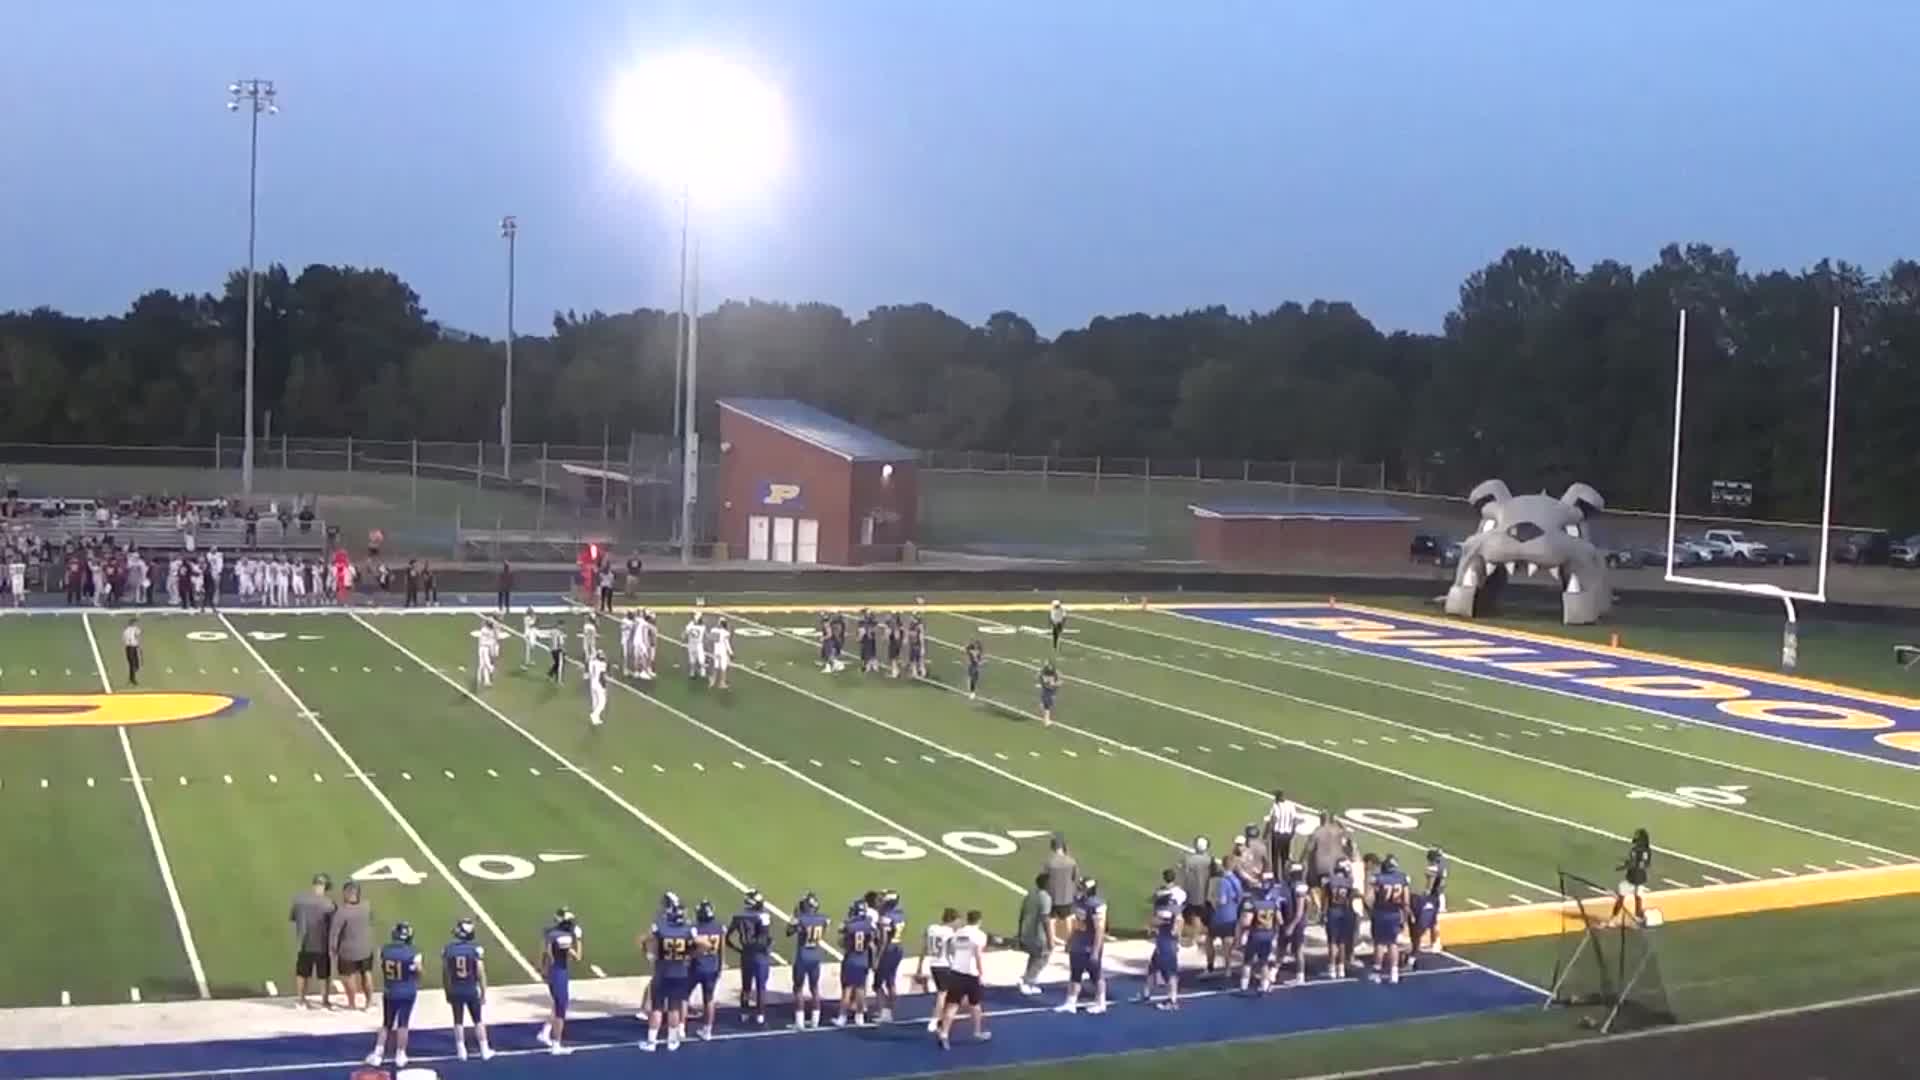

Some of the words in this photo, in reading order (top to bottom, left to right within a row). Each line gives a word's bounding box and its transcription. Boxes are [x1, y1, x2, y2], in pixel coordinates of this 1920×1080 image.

[763, 484, 801, 505] P
[1626, 785, 1747, 808] 10
[845, 831, 1017, 860] 30
[352, 853, 536, 885] 40
[1383, 884, 1403, 901] 72
[662, 938, 687, 961] 52
[854, 931, 865, 952] 8
[384, 960, 402, 980] 51
[455, 956, 468, 977] 9
